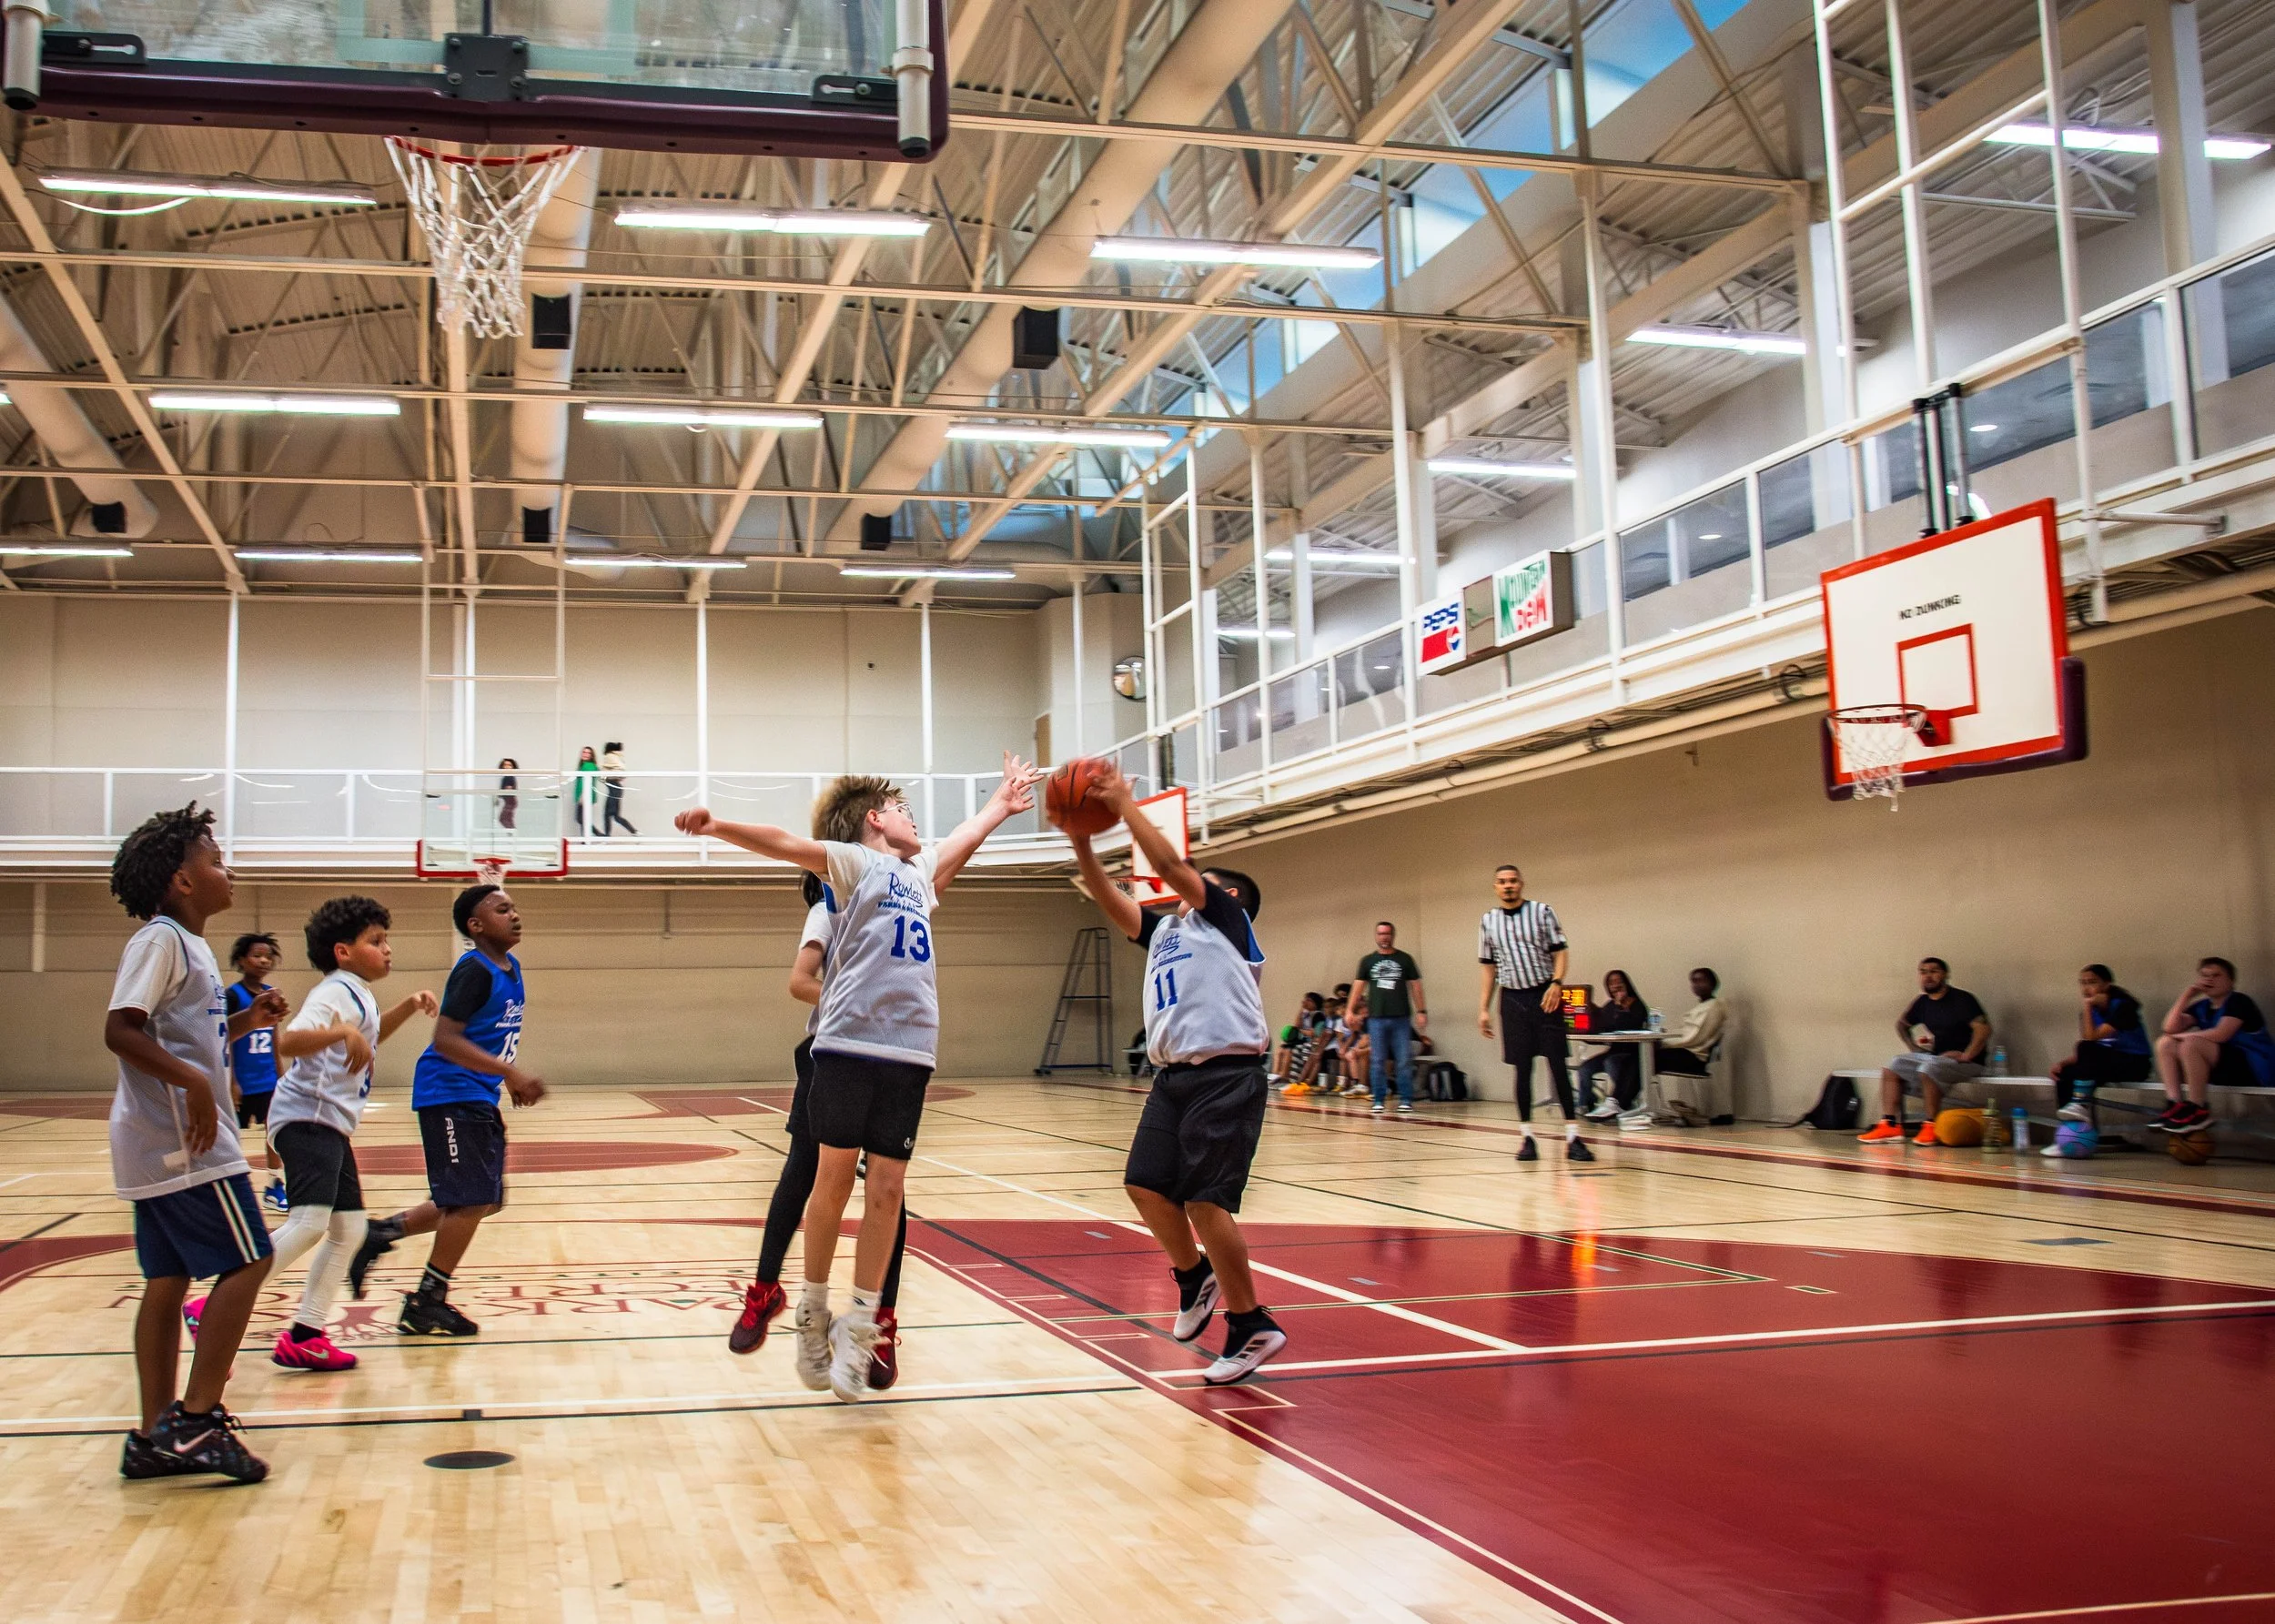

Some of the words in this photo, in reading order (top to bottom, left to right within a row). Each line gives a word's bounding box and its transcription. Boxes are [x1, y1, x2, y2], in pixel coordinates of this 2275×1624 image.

[1423, 602, 1461, 630] PEPS
[890, 915, 930, 963] 13
[1154, 967, 1178, 1012] 11
[248, 1032, 272, 1054] 12
[497, 1031, 521, 1064] 15
